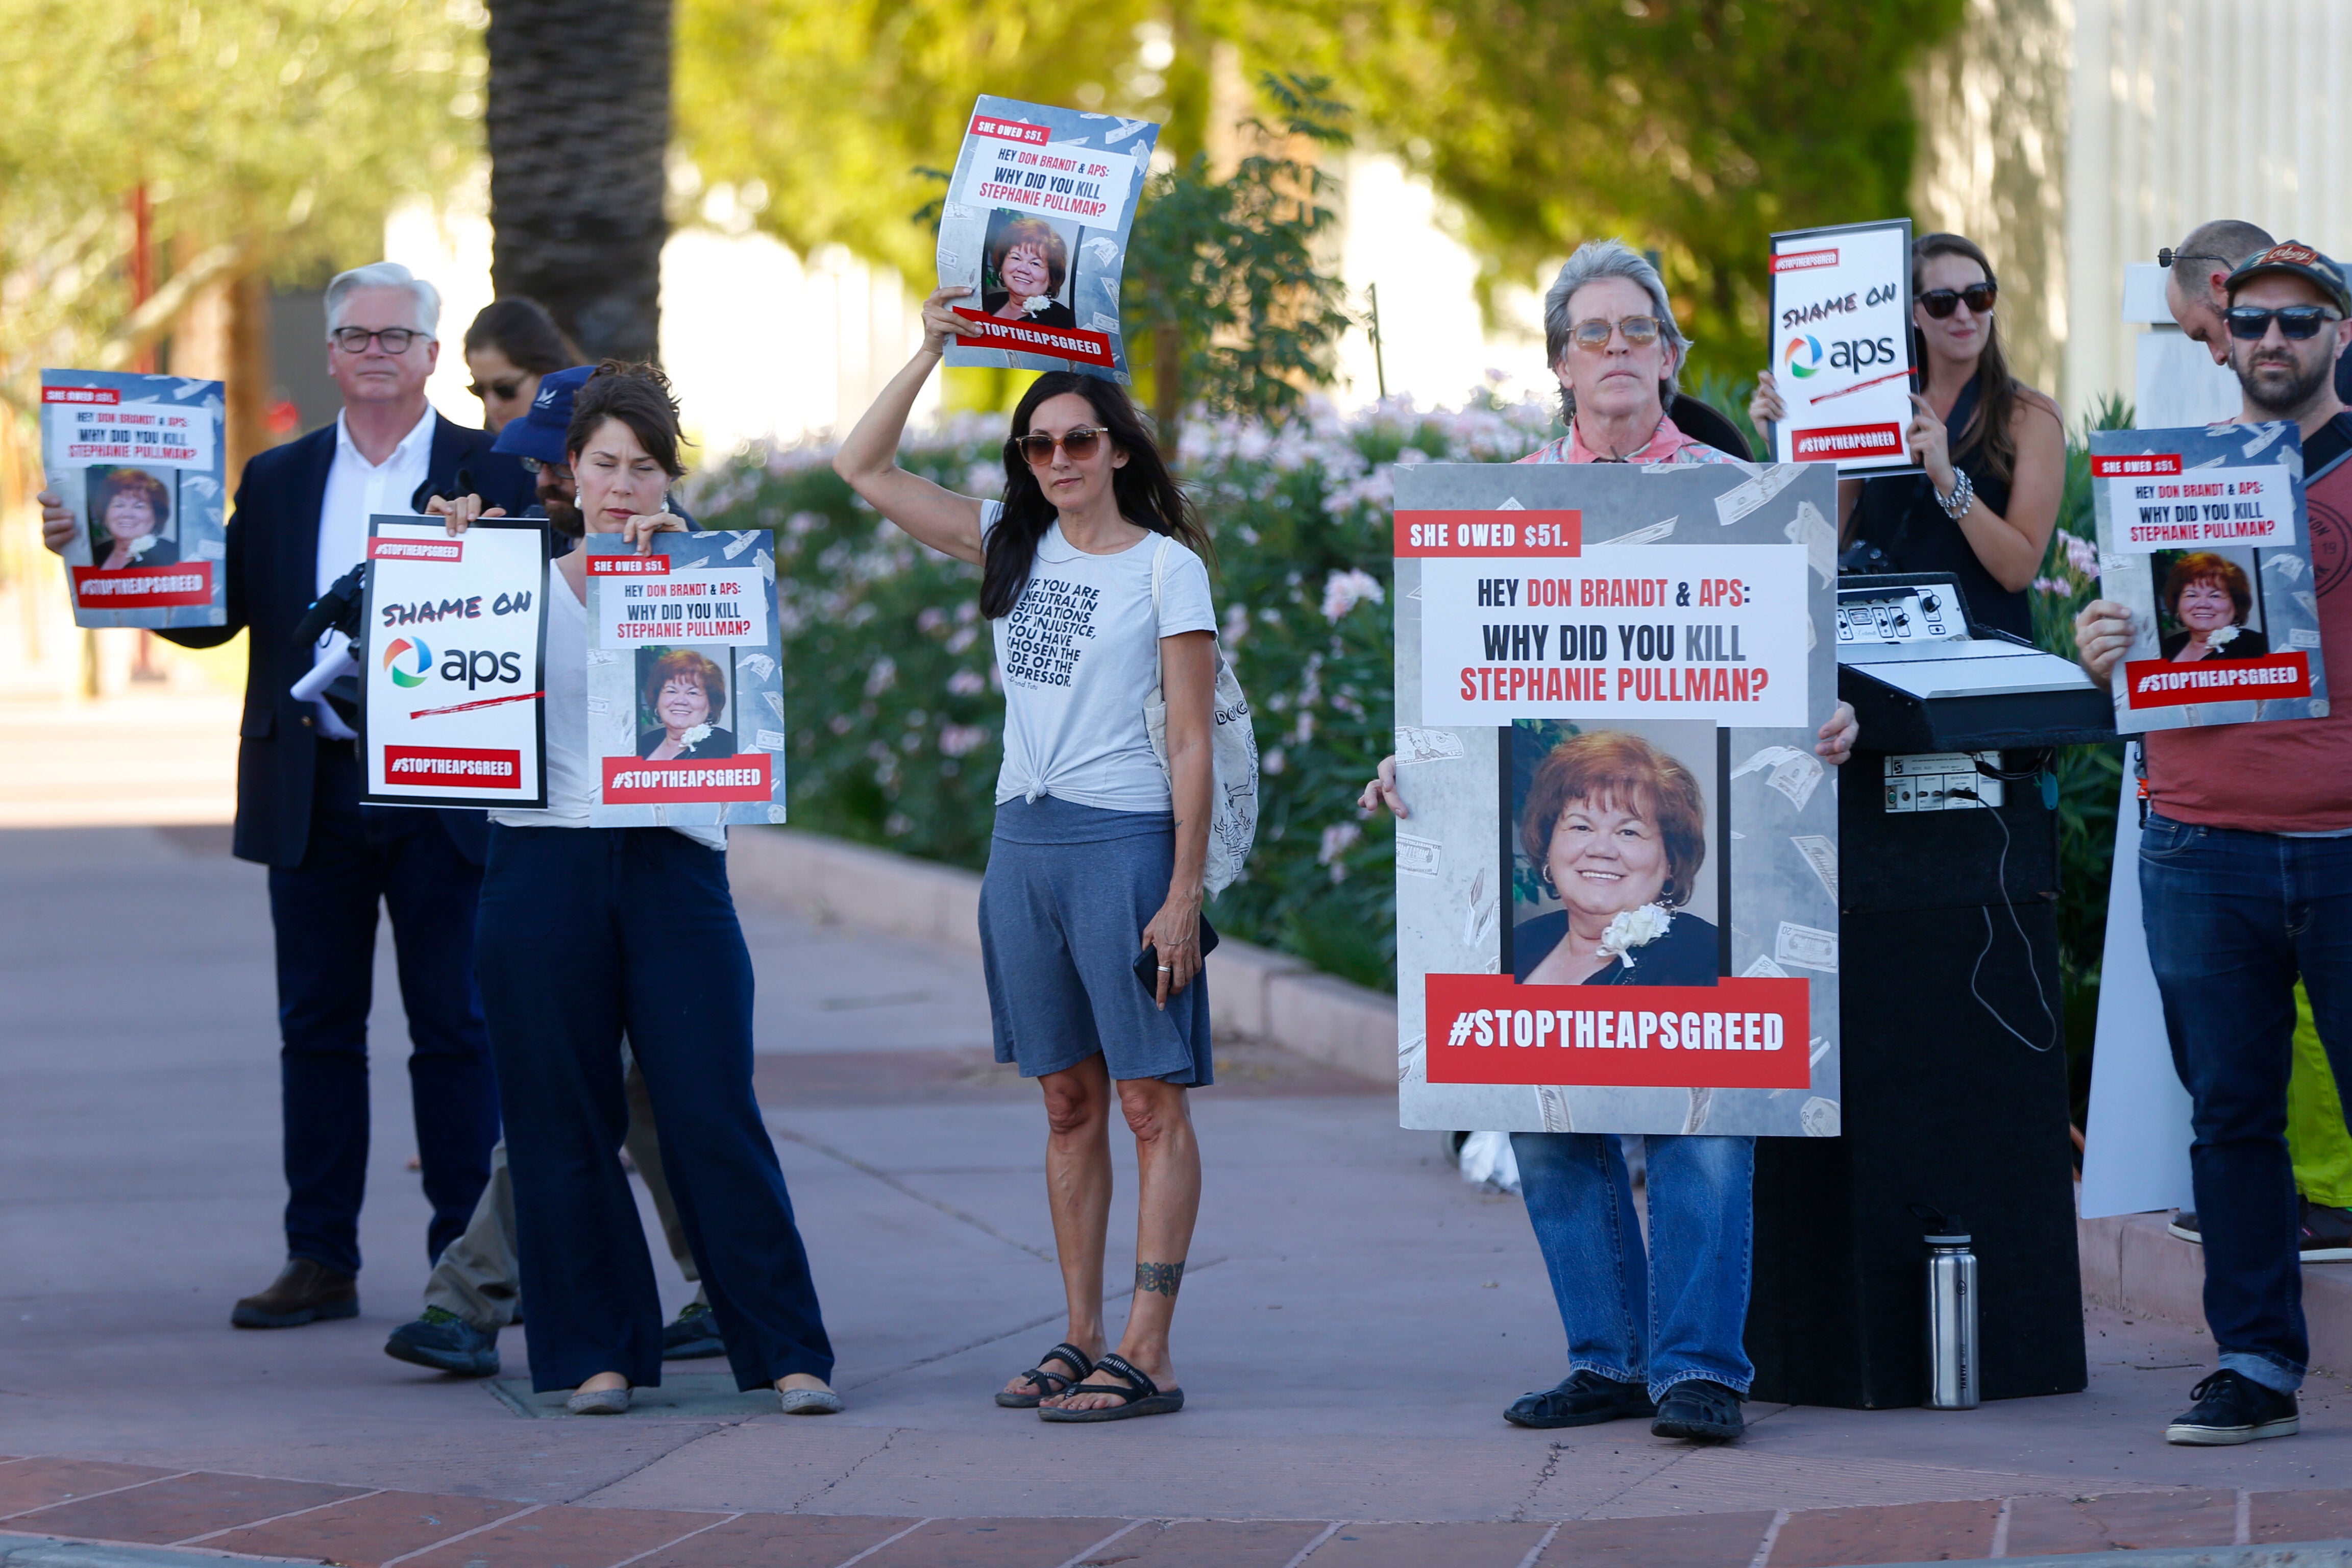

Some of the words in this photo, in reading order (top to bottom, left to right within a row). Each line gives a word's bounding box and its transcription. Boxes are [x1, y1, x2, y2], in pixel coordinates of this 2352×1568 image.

[977, 121, 995, 134] SHE
[997, 125, 1022, 138] OWED
[1025, 129, 1043, 142] $51.
[998, 148, 1016, 161] HEY
[1018, 152, 1037, 165] DON
[1040, 156, 1077, 172] BRANDT
[1078, 163, 1084, 173] &
[1087, 163, 1109, 177] APS:
[994, 167, 1023, 184] WHY
[1024, 172, 1046, 188] DID
[1050, 176, 1073, 193] YOU
[1075, 181, 1100, 200] KILL
[979, 183, 1040, 206] STEPHANIE
[1044, 195, 1106, 217] PULLMAN?
[1775, 252, 1836, 271] #STOPTHEAPSGREED
[1782, 293, 1858, 330] SHAME
[1866, 282, 1897, 307] ON
[1830, 337, 1895, 375] aps
[46, 390, 65, 400] SHE
[67, 392, 93, 402] OWED
[77, 412, 94, 423] HEY
[97, 413, 116, 423] DON
[120, 415, 155, 425] BRANDT
[79, 429, 105, 442] WHY
[111, 430, 130, 443] DID
[136, 431, 158, 444] YOU
[163, 432, 187, 446] KILL
[1798, 431, 1895, 454] #STOPTHEAPSGREED
[68, 445, 129, 458] STEPHANIE
[135, 446, 196, 460] PULLMAN?
[2102, 461, 2121, 473] SHE
[2124, 461, 2151, 473] OWED
[2154, 460, 2176, 472] $51.
[2136, 486, 2154, 499] HEY
[2159, 485, 2179, 498] DON
[2184, 483, 2224, 497] BRANDT
[2228, 484, 2235, 495] &
[2239, 482, 2264, 495] APS:
[2139, 506, 2170, 523] WHY
[2176, 505, 2198, 522] DID
[2203, 503, 2230, 521] YOU
[2235, 502, 2263, 519] KILL
[1410, 524, 1448, 547] SHE
[1458, 524, 1515, 547] OWED
[1525, 523, 1569, 548] $51.
[2130, 525, 2199, 542] STEPHANIE
[2204, 521, 2274, 539] PULLMAN?
[375, 544, 458, 557] #STOPTHEAPSGREED
[594, 561, 613, 572] SHE
[615, 561, 643, 572] OWED
[645, 560, 665, 572] $51.
[80, 574, 203, 595] #STOPTHEAPSGREED
[625, 584, 643, 598] HEY
[647, 584, 666, 597] DON
[670, 583, 706, 596] BRANDT
[710, 585, 716, 595] &
[720, 582, 741, 595] APS:
[1028, 579, 1040, 589] IF
[1043, 579, 1070, 593] YOU
[1072, 585, 1100, 600] ARE
[1478, 579, 1519, 606] HEY
[1528, 579, 1572, 606] DON
[1581, 579, 1668, 606] BRANDT
[1676, 582, 1690, 606] &
[1699, 579, 1750, 606] APS:
[382, 596, 482, 627] SHAME
[493, 591, 532, 616] ON
[627, 604, 656, 621] WHY
[663, 604, 681, 620] DID
[688, 603, 710, 620] YOU
[715, 602, 740, 619] KILL
[1022, 591, 1077, 608] NEUTRAL
[1080, 599, 1098, 611] IN
[1016, 602, 1091, 623] SITUATIONS
[618, 622, 682, 638] STEPHANIE
[687, 621, 750, 636] PULLMAN?
[1008, 623, 1037, 639] YOU
[1041, 632, 1072, 647] HAVE
[1012, 611, 1032, 624] OF
[1033, 617, 1096, 640] INJUSTICE,
[1483, 625, 1548, 661] WHY
[1560, 625, 1606, 661] DID
[1618, 625, 1674, 661] YOU
[1685, 625, 1746, 661] KILL
[1033, 656, 1052, 669] OF
[1055, 660, 1073, 674] THE
[1061, 648, 1081, 662] THE
[440, 649, 521, 690] aps
[2138, 667, 2297, 693] #STOPTHEAPSGREED
[1460, 668, 1607, 702] STEPHANIE
[1618, 668, 1769, 702] PULLMAN?
[391, 758, 512, 776] #STOPTHEAPSGREED
[612, 769, 761, 790] #STOPTHEAPSGREED
[1448, 1009, 1784, 1051] #STOPTHEAPSGREED
